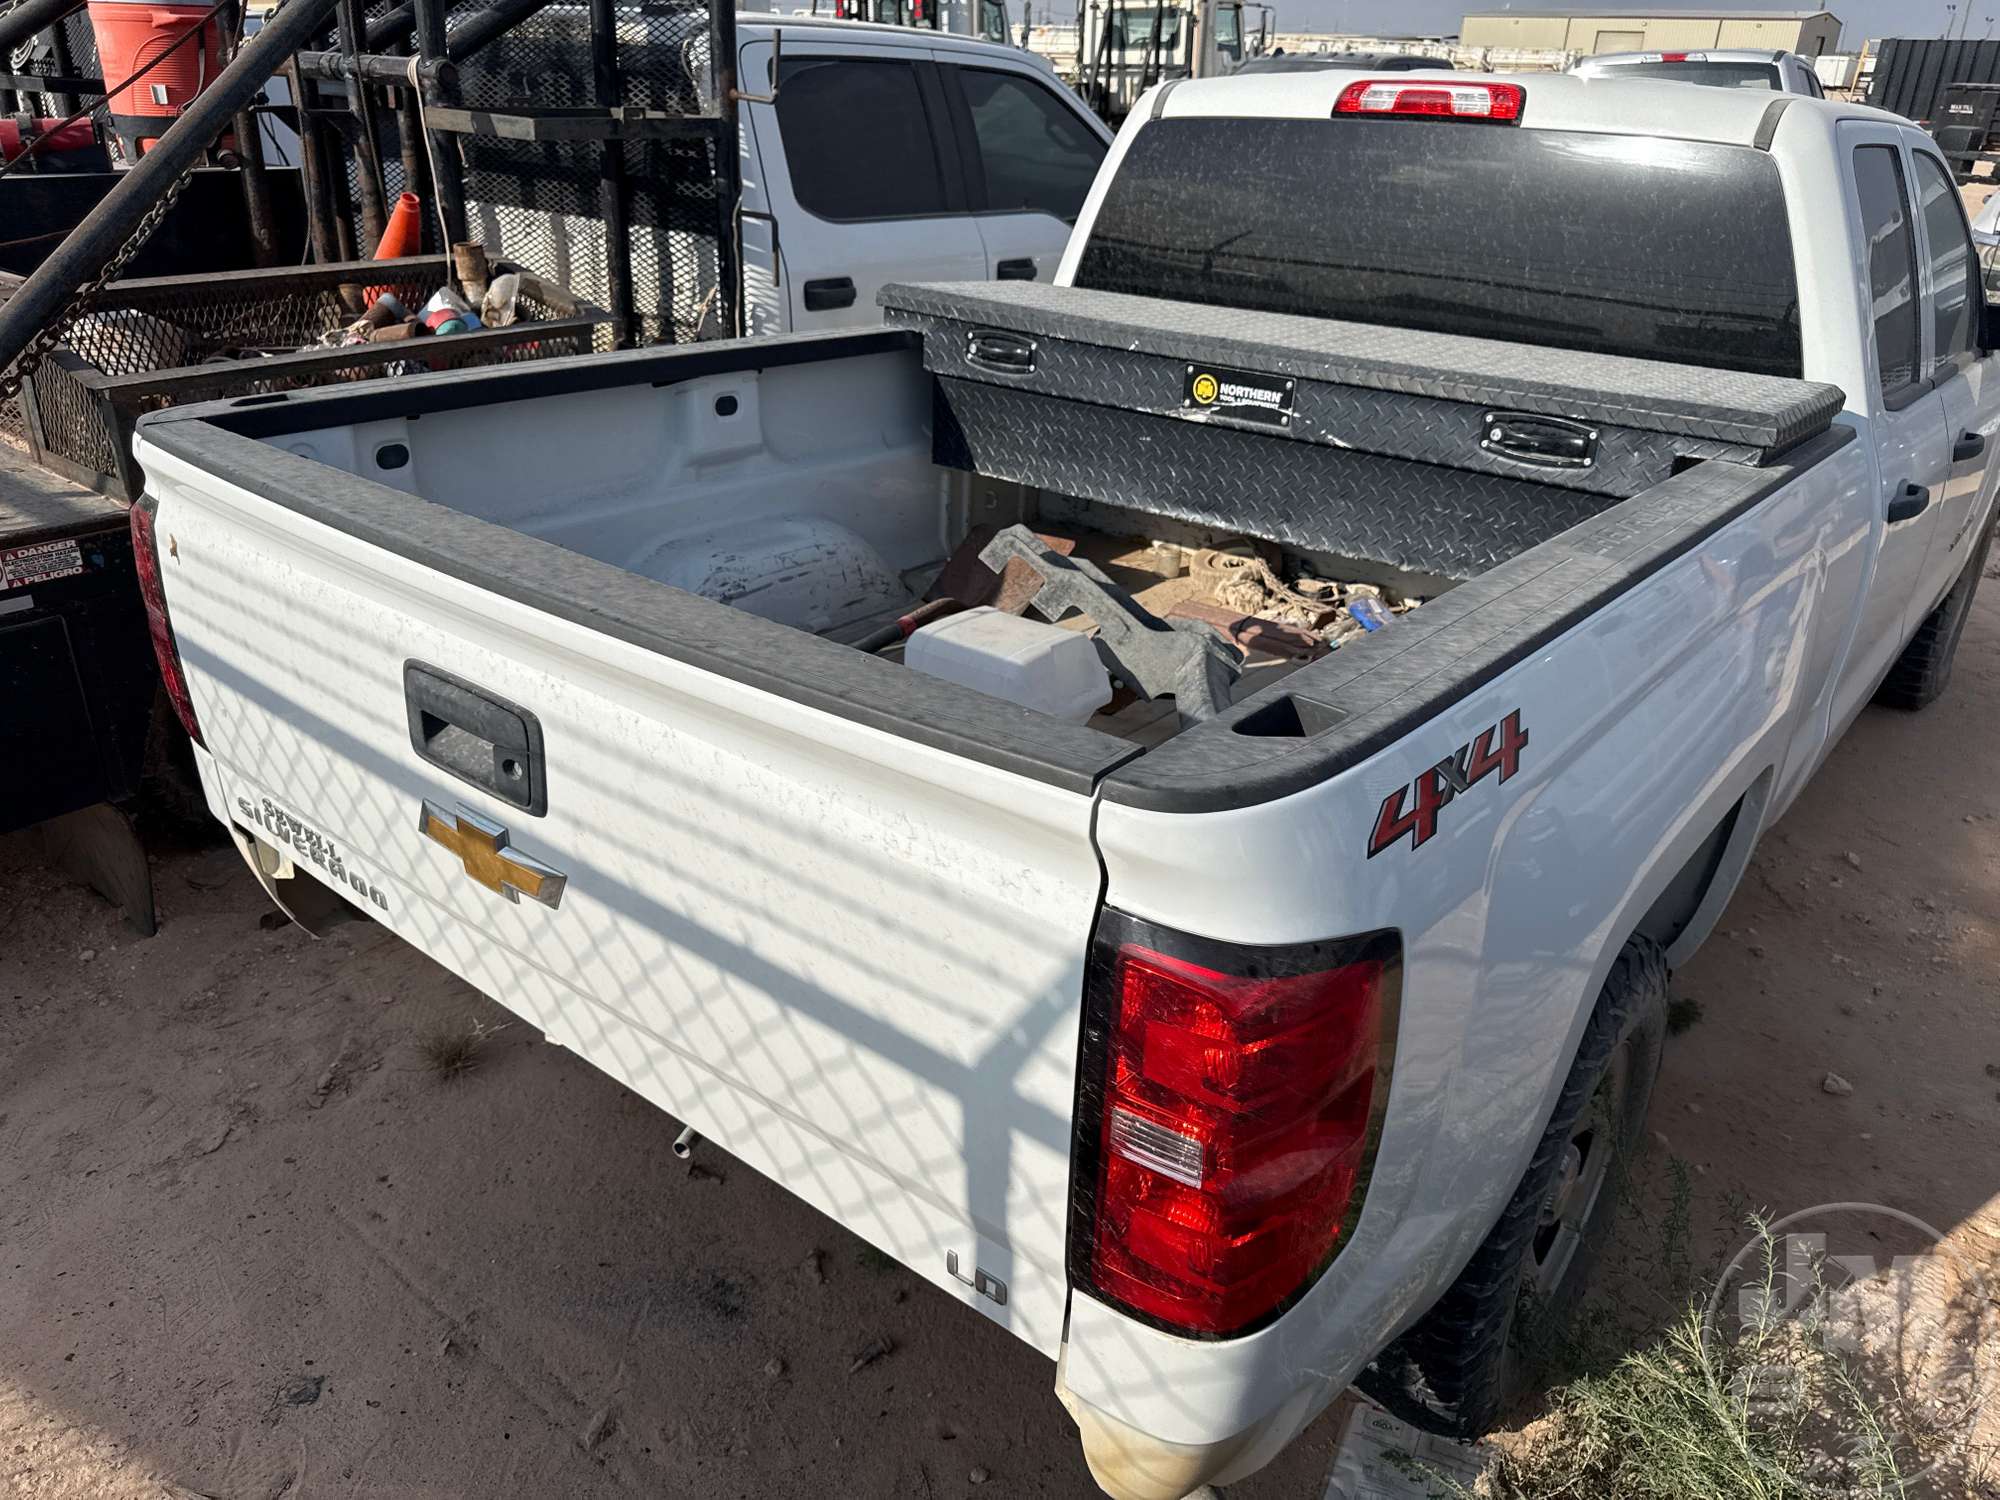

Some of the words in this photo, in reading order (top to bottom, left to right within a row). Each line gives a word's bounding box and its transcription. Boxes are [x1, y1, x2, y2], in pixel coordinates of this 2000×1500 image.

[1220, 383, 1282, 403] NORTHERN
[17, 540, 77, 558] DANGER
[24, 566, 83, 584] PELIGRO
[261, 798, 342, 863] SEWELL
[238, 797, 389, 911] SILVERADO
